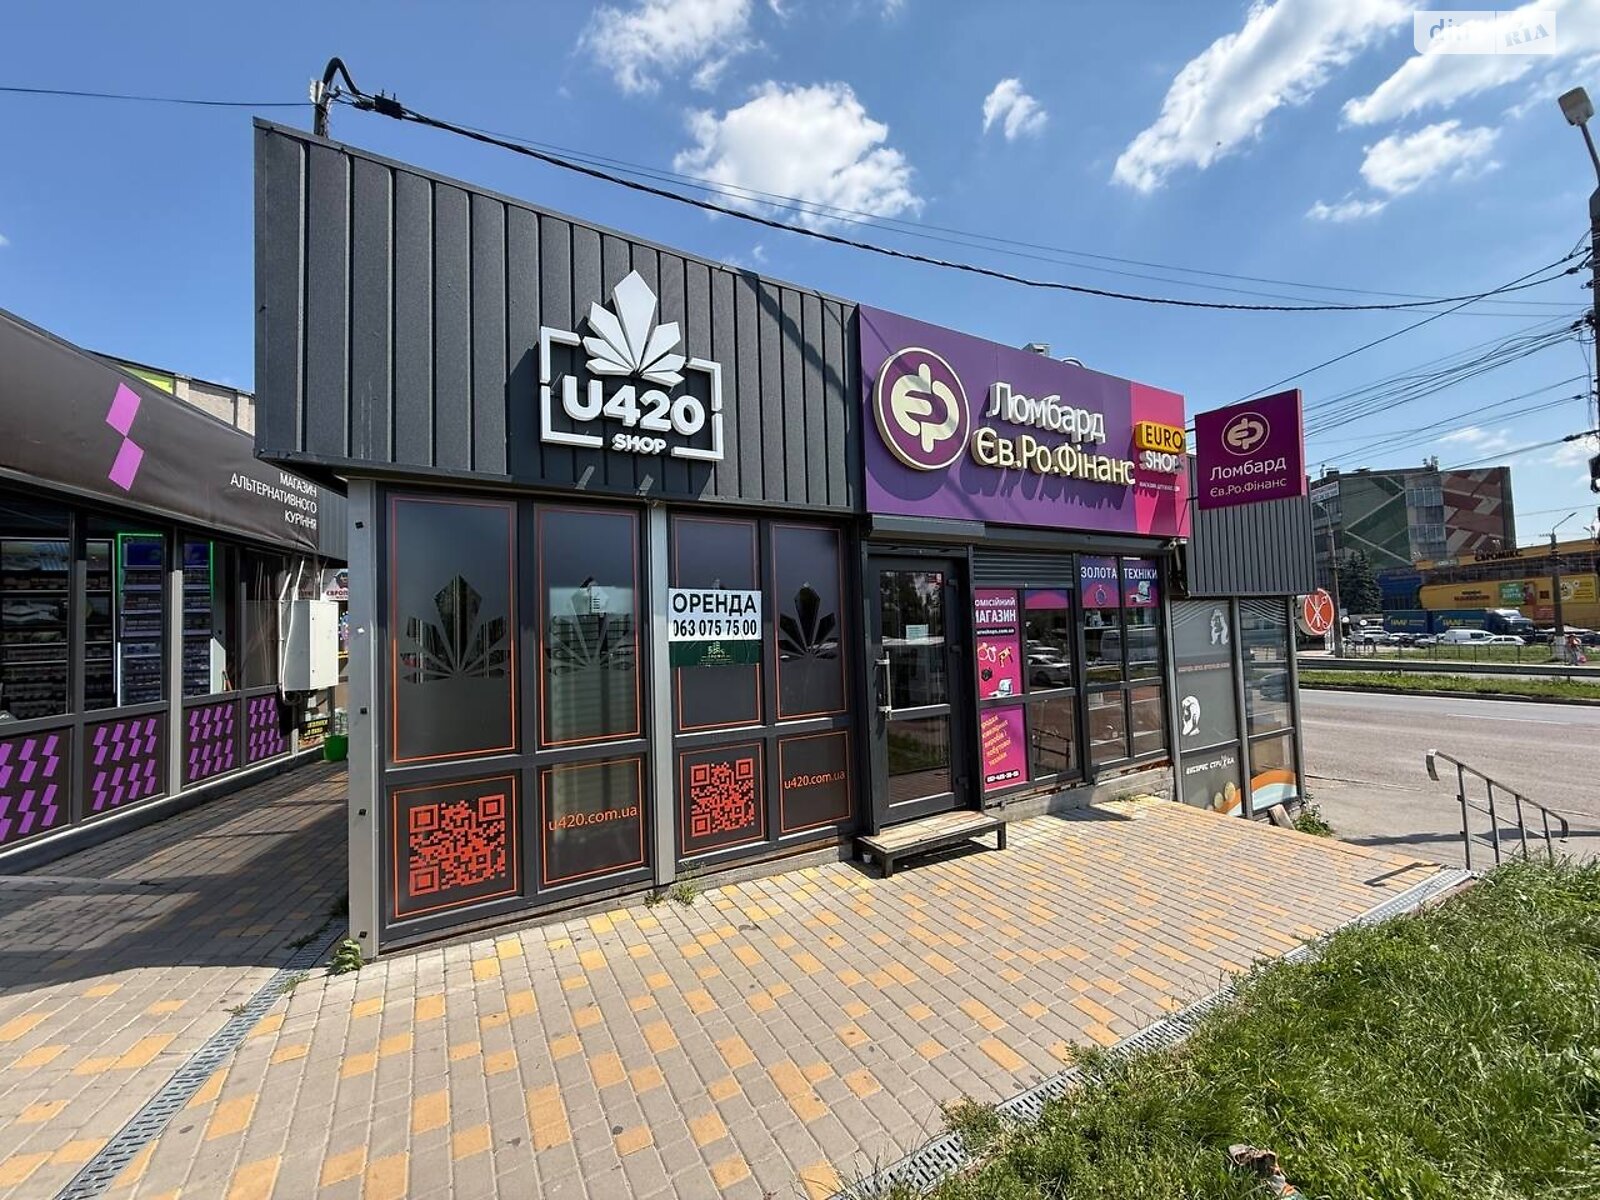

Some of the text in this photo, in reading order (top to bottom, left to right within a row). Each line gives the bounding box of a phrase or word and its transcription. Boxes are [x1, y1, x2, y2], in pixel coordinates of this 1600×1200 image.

[562, 374, 706, 436] U420
[986, 381, 1107, 445] Ломбард
[612, 433, 667, 455] SHOP
[1145, 424, 1184, 449] EURO
[972, 426, 1136, 485] Єв.Ро.Фінанс
[1209, 457, 1287, 481] Ломбард
[230, 472, 317, 514] АЛЬТЕРНАТИВНОГО
[280, 472, 317, 498] МАГАЗИН
[1209, 478, 1288, 498] Єв.Ро.Фінанс
[1080, 566, 1157, 579] ЗОЛОТА ТЕХНІКИ
[673, 593, 757, 617] ОРЕНДА
[974, 596, 1016, 607] ОМІСІЙНИЙ
[673, 619, 757, 637] 063 075 75 00
[784, 770, 846, 790] u420.com.ua
[548, 805, 639, 831] u420.com.ua
